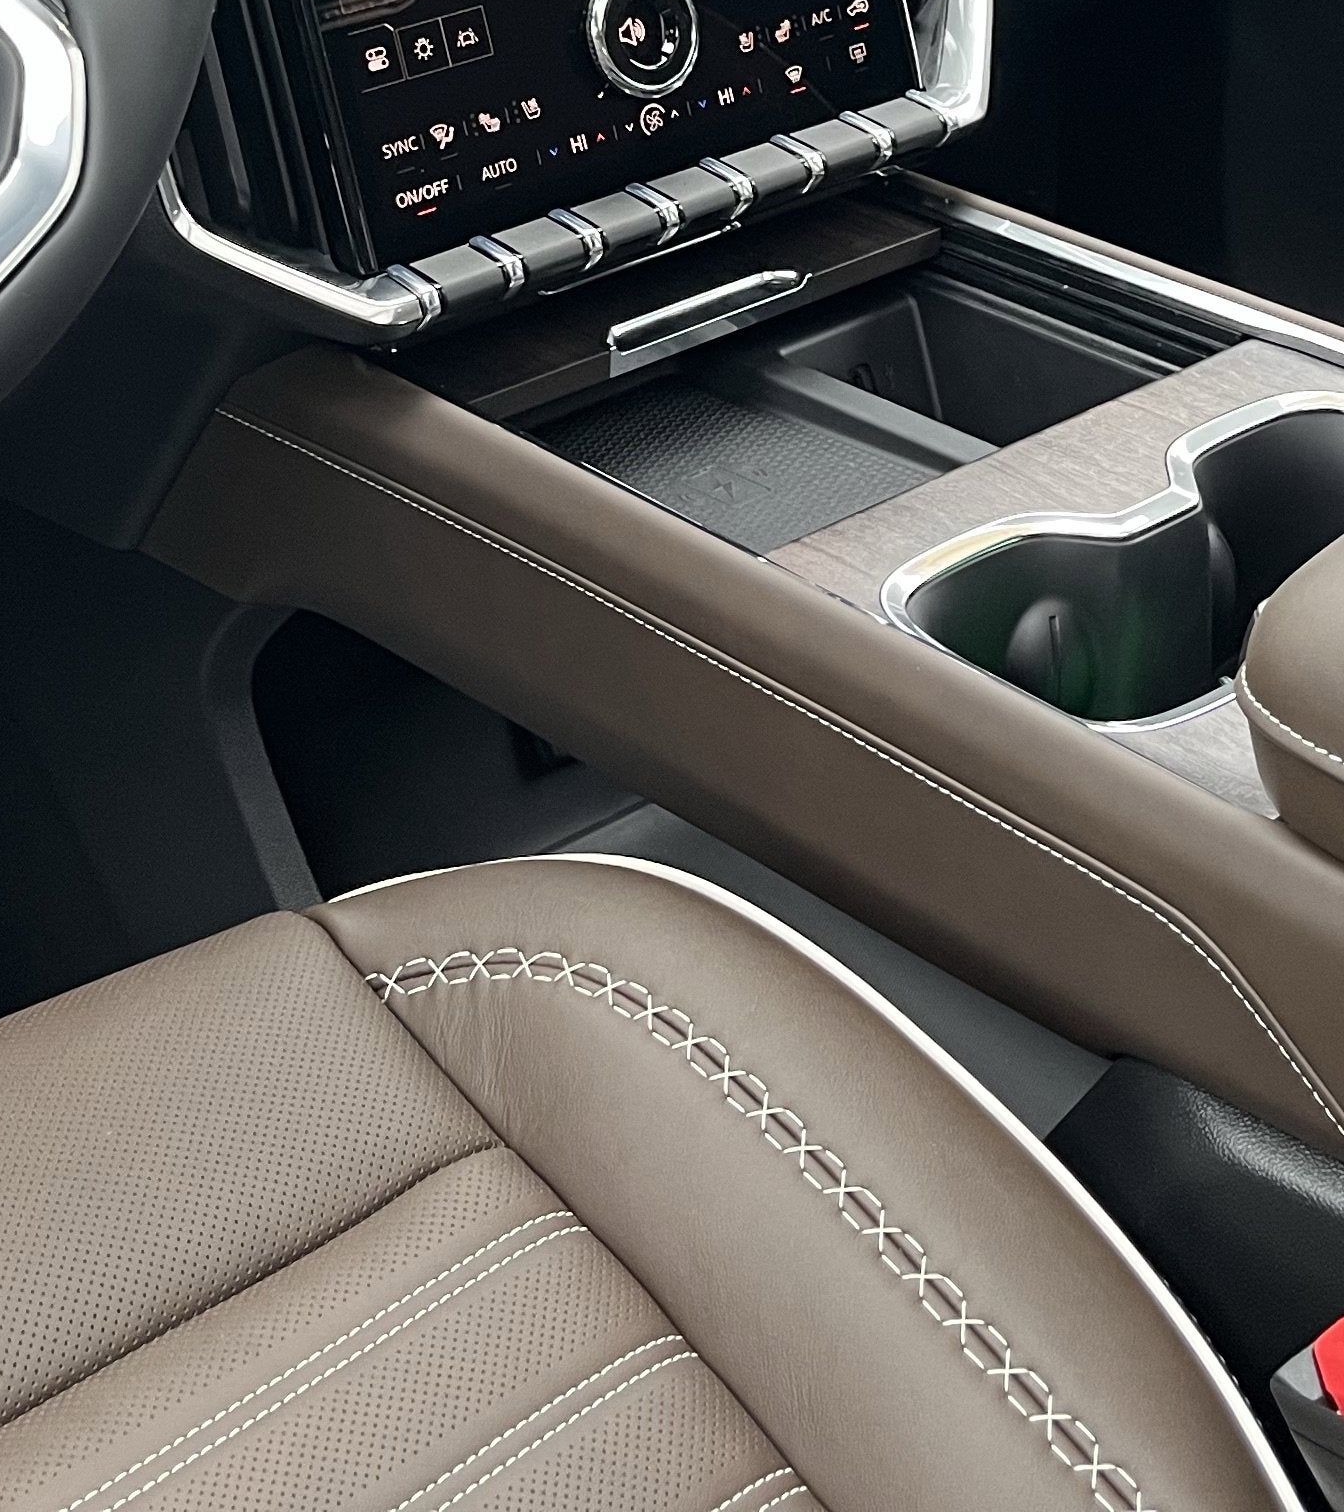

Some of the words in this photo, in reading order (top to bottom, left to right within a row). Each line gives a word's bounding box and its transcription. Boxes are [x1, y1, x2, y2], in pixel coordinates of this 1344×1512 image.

[811, 8, 833, 26] A/C
[717, 86, 735, 106] HI
[381, 135, 419, 160] SYNC
[569, 133, 589, 154] HI
[481, 157, 518, 182] AUTO
[394, 178, 449, 209] ON/OFF
